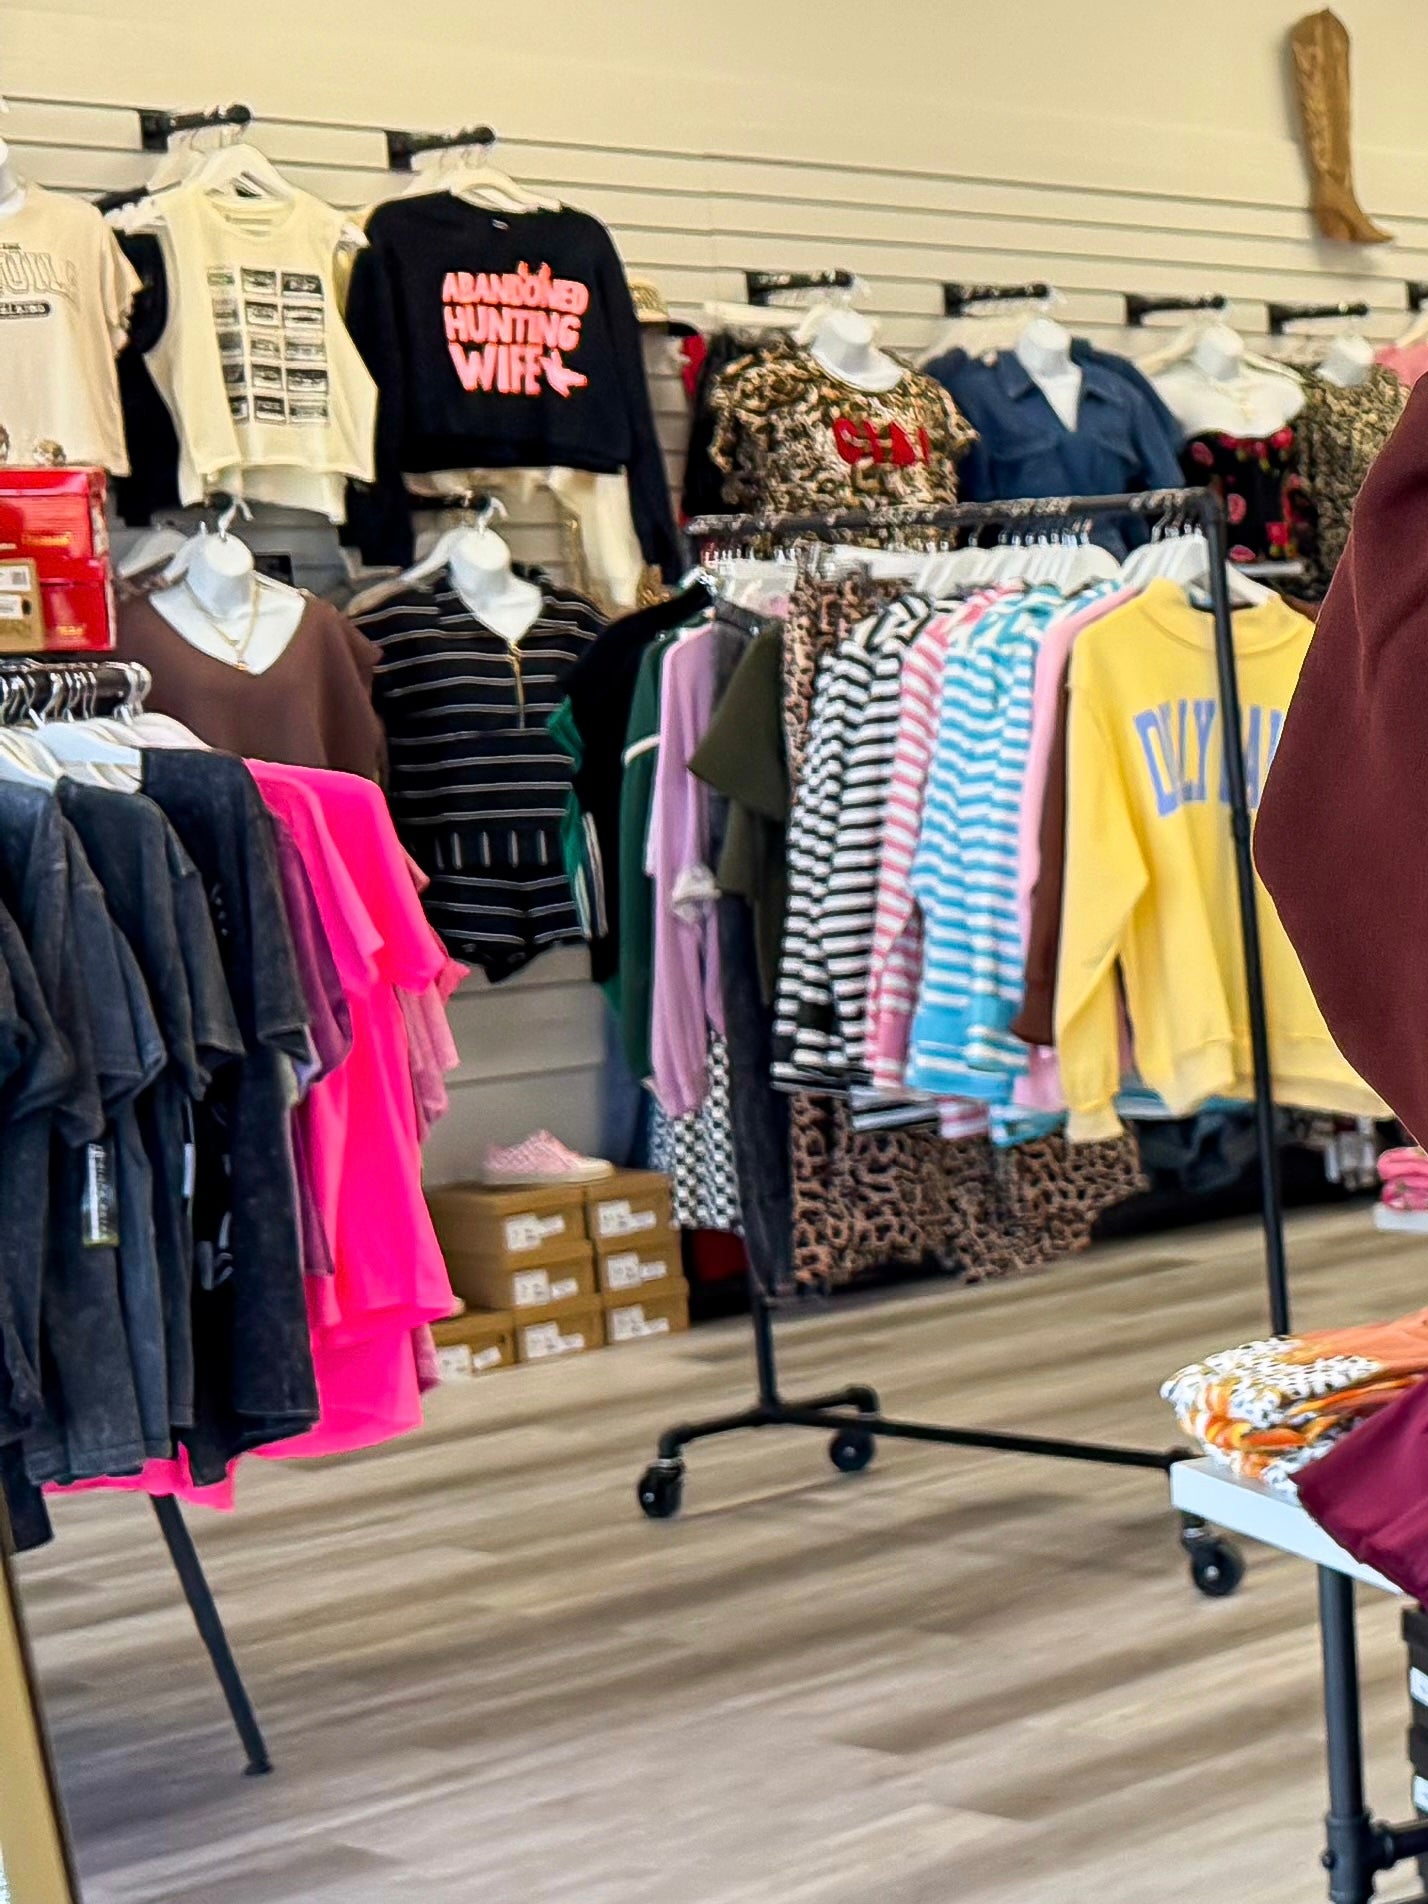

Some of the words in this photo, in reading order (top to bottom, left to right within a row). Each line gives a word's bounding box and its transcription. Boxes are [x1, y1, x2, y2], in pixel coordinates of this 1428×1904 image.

[442, 271, 590, 316] ABANDONED
[443, 304, 582, 352] HUNTING
[448, 342, 545, 395] WIFE
